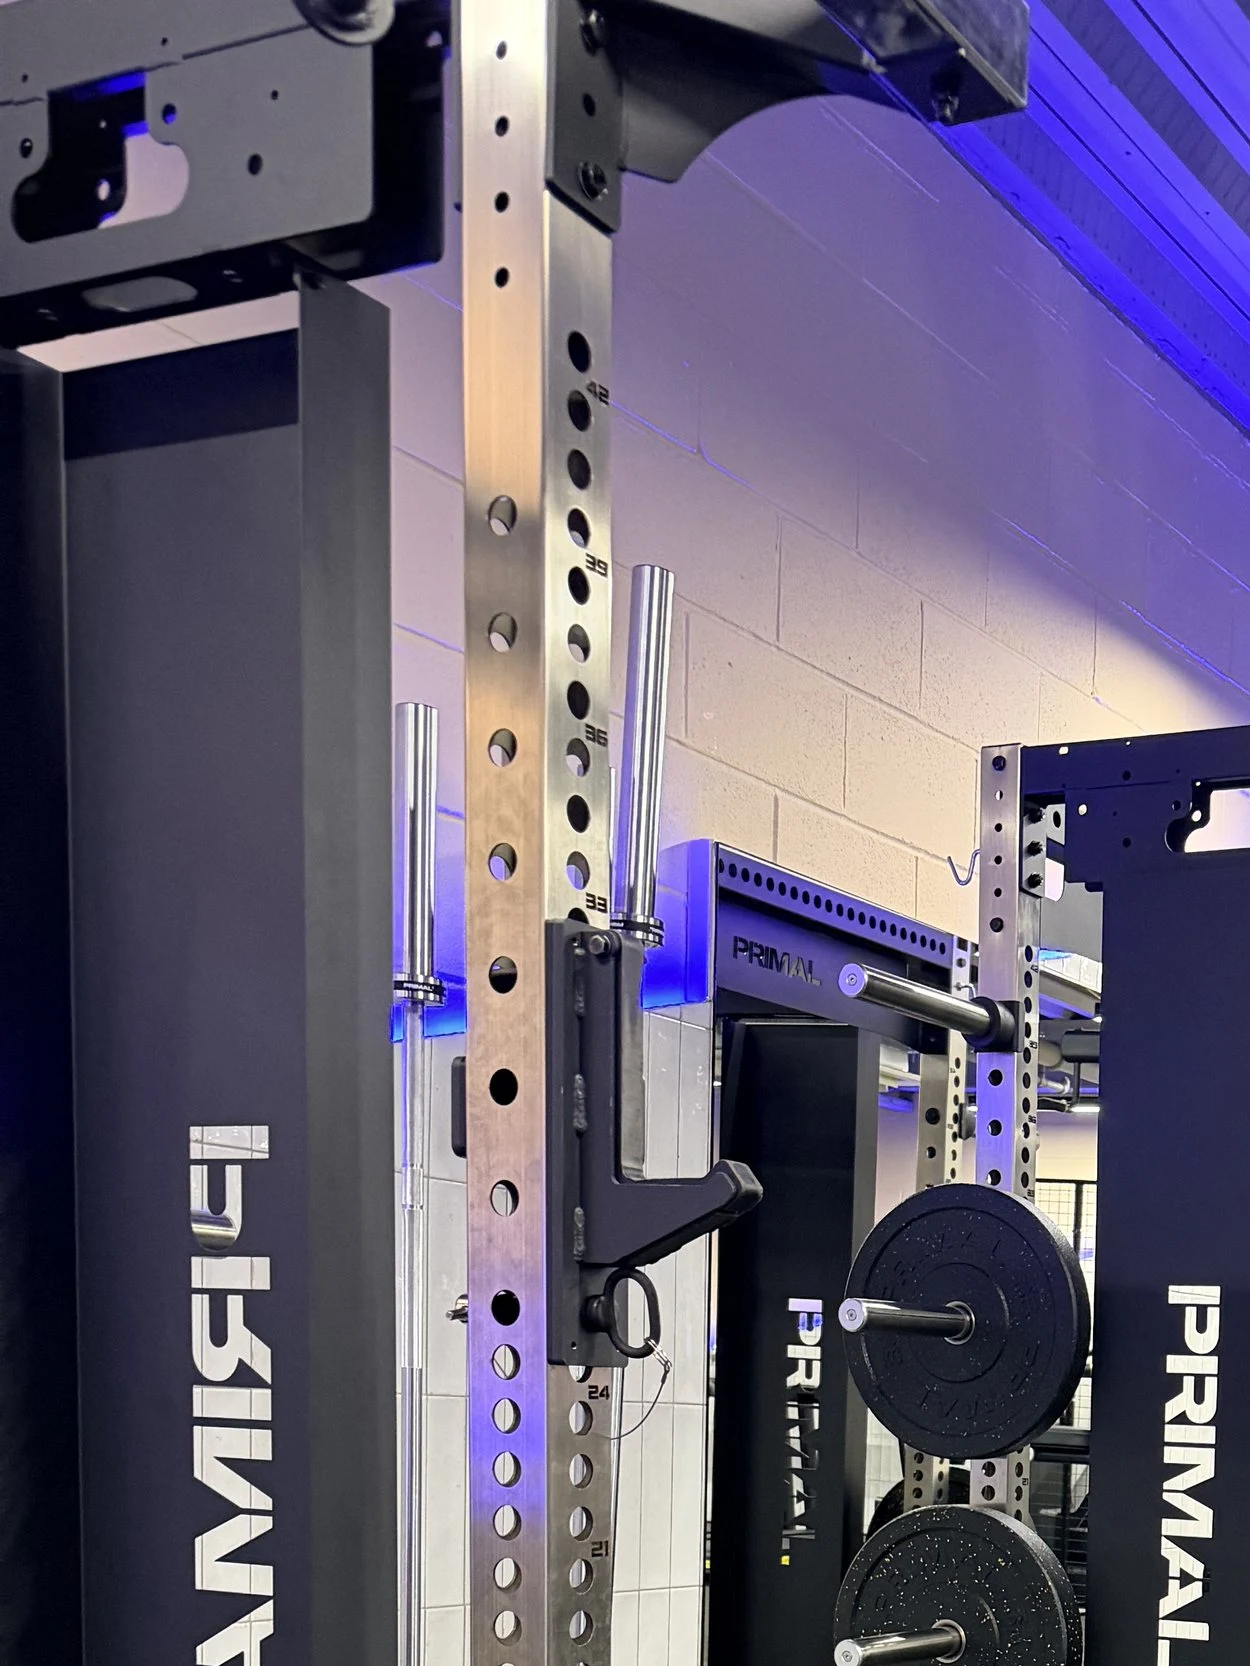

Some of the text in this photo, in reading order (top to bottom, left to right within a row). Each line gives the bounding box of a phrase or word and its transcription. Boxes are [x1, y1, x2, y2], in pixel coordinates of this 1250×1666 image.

[587, 381, 609, 406] 42
[585, 553, 608, 578] 39
[585, 723, 608, 748] 36
[586, 892, 608, 914] 33
[733, 935, 822, 986] PRIMAL
[587, 1384, 610, 1401] 24
[591, 1540, 609, 1558] 21
